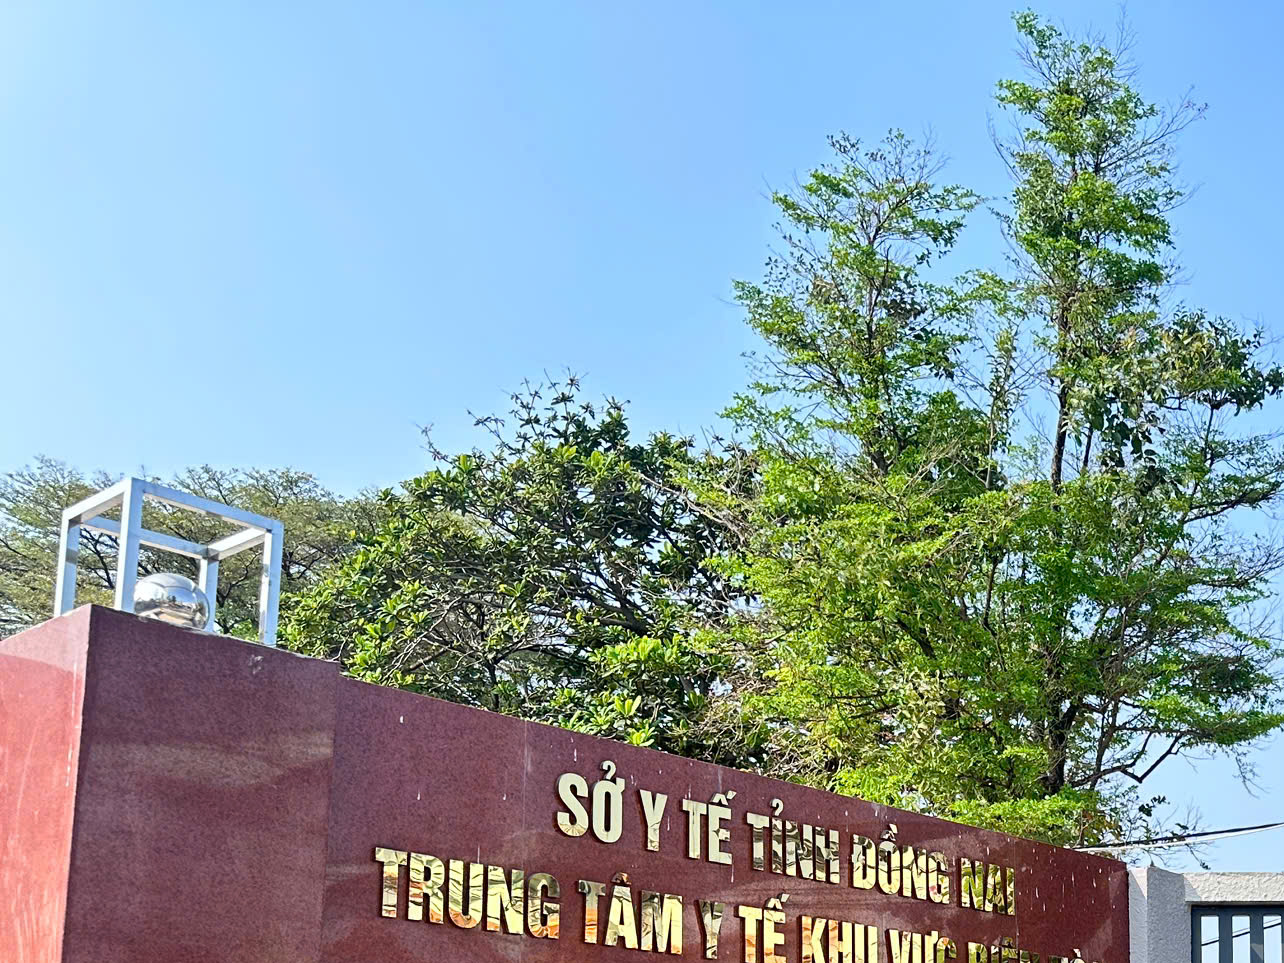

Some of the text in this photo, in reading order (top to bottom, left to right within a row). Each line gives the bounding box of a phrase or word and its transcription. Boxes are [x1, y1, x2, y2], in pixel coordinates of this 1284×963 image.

[374, 847, 561, 940] TRUNG
[579, 872, 684, 955] TÂM
[697, 900, 723, 959] Y
[556, 760, 1016, 915] SỞ Y TẾ TỈNH ĐỒNG NAI
